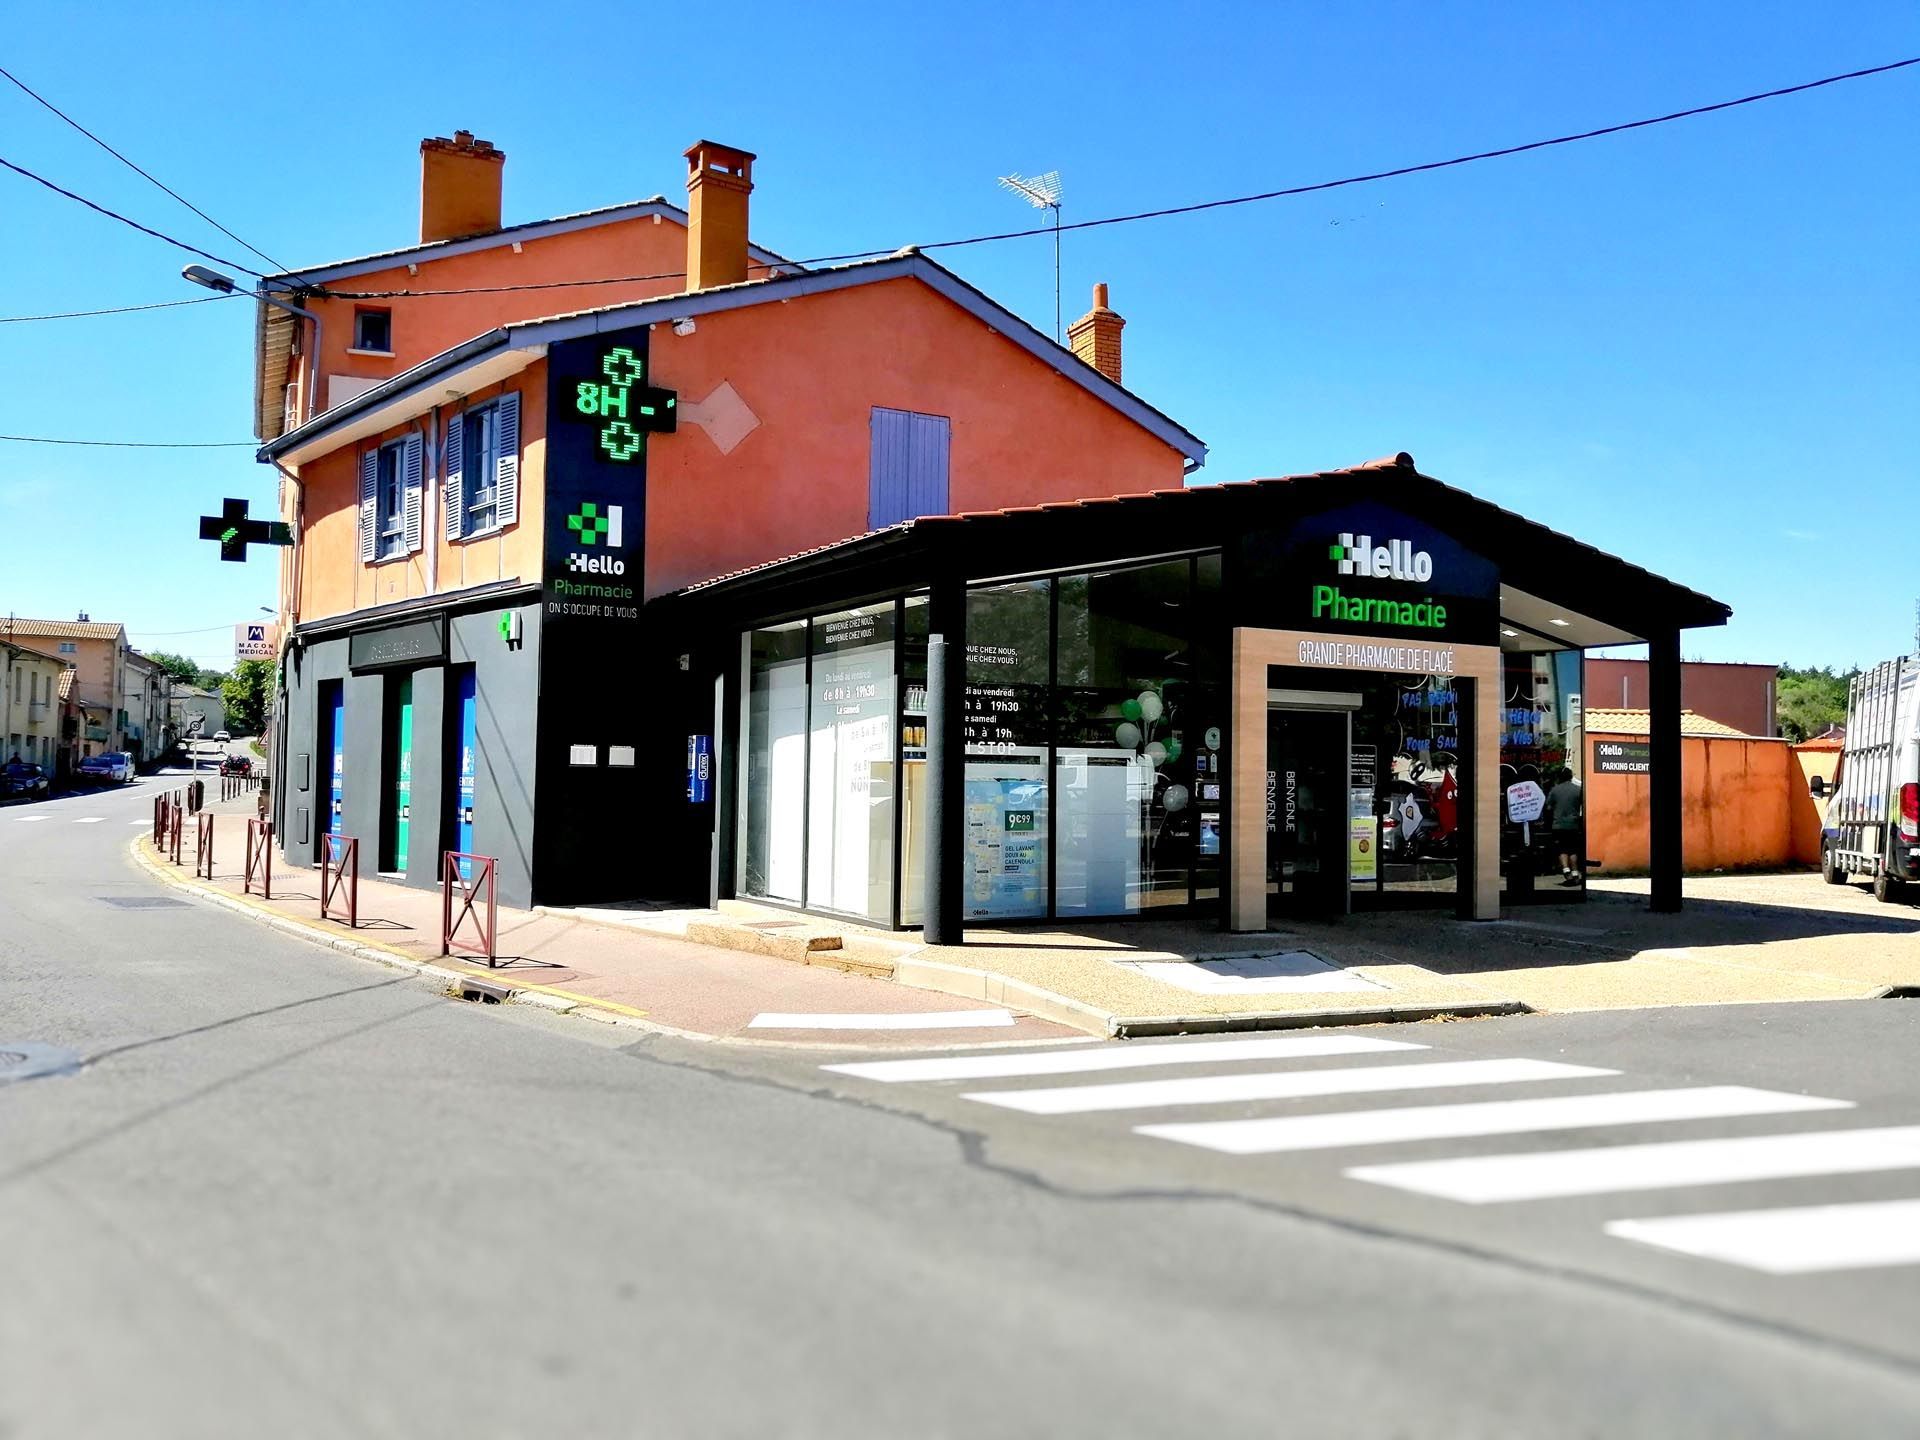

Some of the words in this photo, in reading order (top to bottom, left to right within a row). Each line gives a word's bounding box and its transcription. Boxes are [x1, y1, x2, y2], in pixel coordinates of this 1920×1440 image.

[569, 553, 625, 575] Hello
[1335, 533, 1432, 582] Hello
[555, 579, 633, 599] Pharmacie
[549, 602, 560, 613] ON
[564, 603, 601, 616] S'OCCUPE
[604, 606, 614, 616] DE
[617, 607, 637, 618] VOUS
[1312, 585, 1447, 628] Pharmacie
[826, 620, 848, 632] BIENVENUE
[849, 618, 861, 628] CHEZ
[826, 632, 848, 643] BIENVENUE
[849, 631, 860, 640] CHEZ
[980, 646, 997, 654] CHEZ
[998, 647, 1018, 656] NOUS,
[1299, 641, 1343, 665] GRANDE
[1346, 644, 1405, 670] PHARMACIE
[1407, 649, 1420, 670] DE
[1423, 646, 1453, 672] FLACÉ
[824, 689, 833, 700] de
[983, 688, 1015, 696] vendredi
[976, 700, 981, 709] à
[991, 701, 1019, 711] 19h30
[971, 715, 997, 723] samedi
[981, 727, 987, 737] à
[996, 728, 1012, 738] 19h
[978, 741, 1016, 754] STOP
[1600, 744, 1623, 755] Hello
[700, 754, 708, 778] durex
[1602, 762, 1628, 770] PARKING
[1267, 771, 1276, 832] BIENVENUE
[1286, 771, 1295, 832] BIENVENUE
